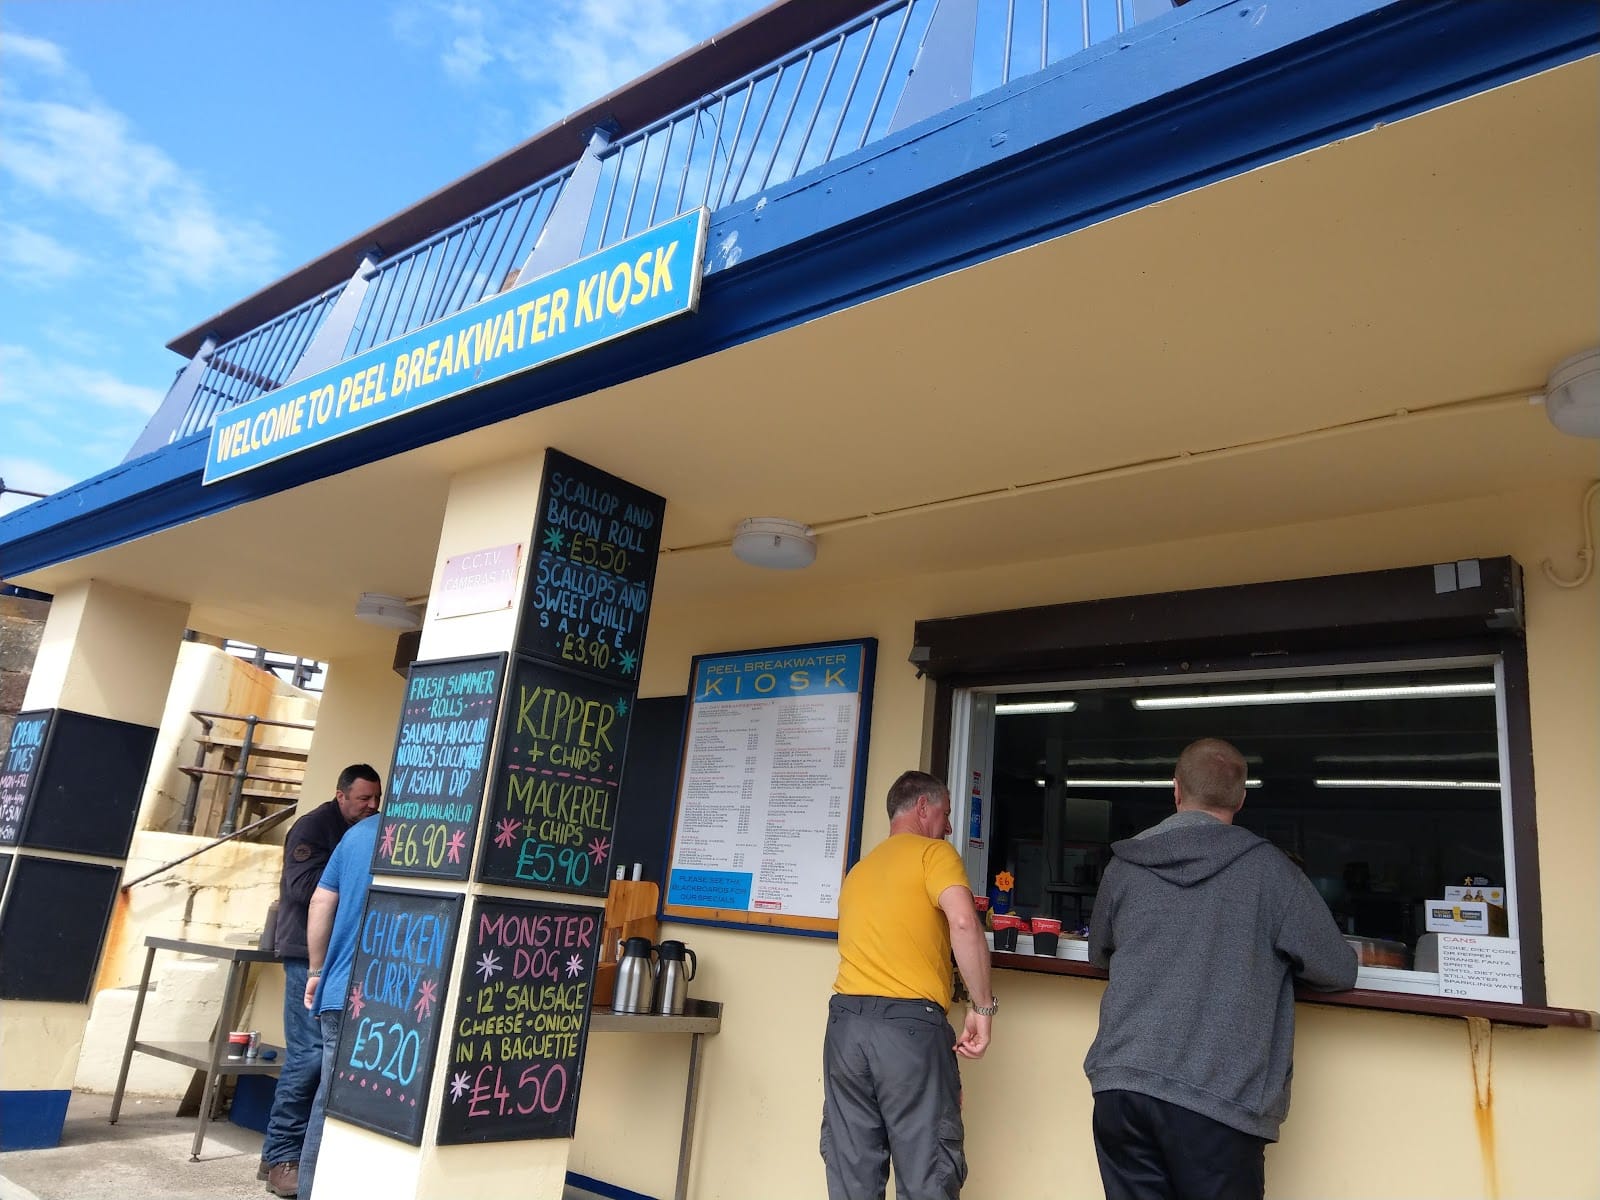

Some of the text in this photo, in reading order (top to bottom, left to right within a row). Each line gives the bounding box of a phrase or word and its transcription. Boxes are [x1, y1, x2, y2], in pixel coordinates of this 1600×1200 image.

[216, 240, 680, 463] WELCOME TO PEEL BREAKWATER KIOSK
[550, 472, 655, 530] SCALLOP AND
[547, 497, 646, 553] BACON ROLL
[569, 532, 627, 574] £5.50
[536, 558, 647, 613] SCALLOPS AND
[533, 585, 634, 634] SWEET CHILLI
[540, 611, 624, 648] SAUCE
[561, 633, 610, 670] £3.90
[706, 654, 847, 675] PEEL BREAKWATER
[410, 670, 495, 701] FRESH SUMMER
[704, 668, 846, 696] KIOSK
[430, 698, 463, 719] ROLLS
[516, 685, 616, 753] KIPPER
[10, 720, 47, 748] OPENING
[7, 746, 36, 772] TIMES
[527, 741, 602, 773] + CHIPS
[408, 770, 445, 796] ASIAN
[449, 769, 472, 797] DIP
[386, 802, 419, 820] LIMITED
[507, 773, 611, 832] MACKEREL
[391, 823, 447, 868] £6.90
[522, 819, 584, 847] + CHIPS
[515, 837, 591, 887] £5.90
[362, 909, 449, 969] CHICKEN
[479, 912, 595, 949] MONSTER
[1443, 936, 1477, 944] CANS
[512, 948, 560, 983] DOG
[1443, 979, 1493, 988] SPARKLING
[363, 958, 423, 1014] CURRY
[505, 981, 588, 1012] SAUSAGE
[459, 1012, 583, 1038] CHEESE ONION
[349, 1016, 421, 1087] £5.20
[456, 1032, 577, 1063] IN A BAGUETTE
[468, 1063, 567, 1118] £4.50
